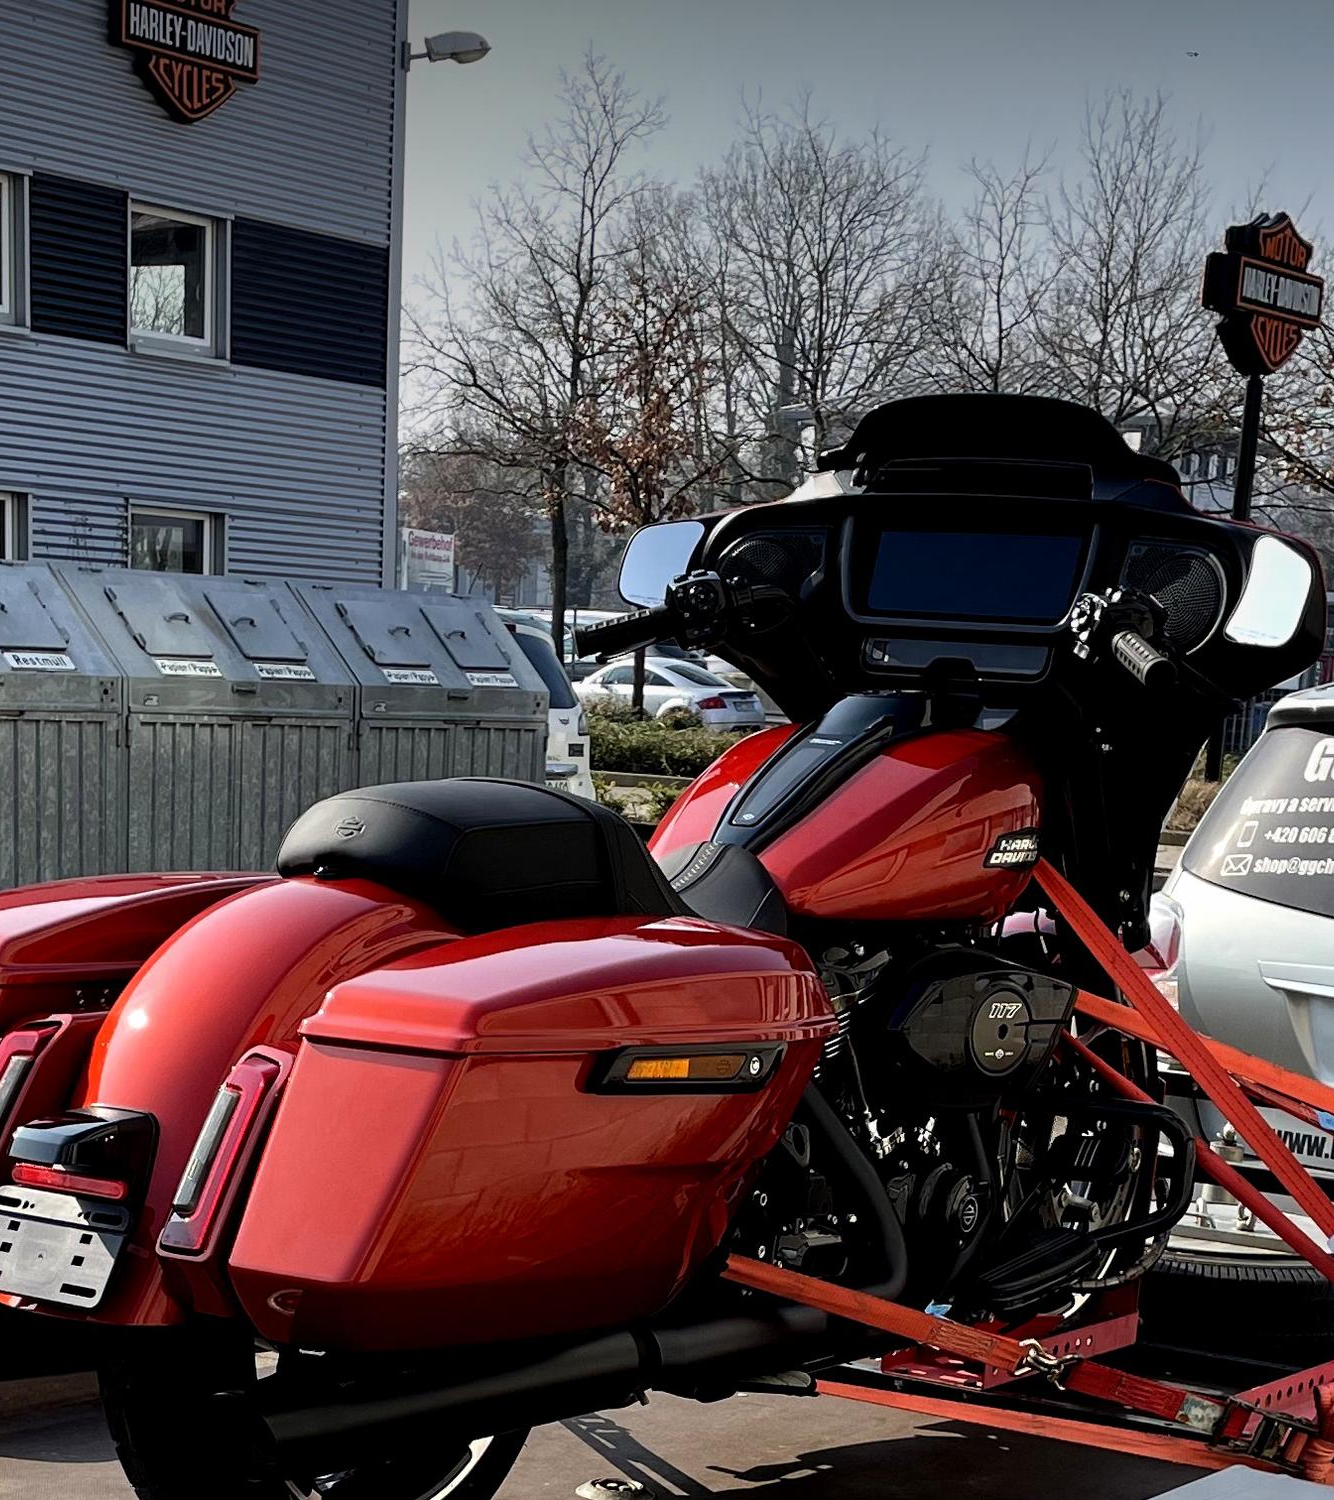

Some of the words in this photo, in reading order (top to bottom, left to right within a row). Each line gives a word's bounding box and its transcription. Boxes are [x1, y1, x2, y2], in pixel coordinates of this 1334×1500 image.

[130, 2, 254, 68] HARLEY-DAVIDSON
[159, 58, 225, 109] CYCLES
[1266, 227, 1307, 268] MOTOR
[1258, 316, 1298, 363] CYCLES
[14, 653, 67, 666] Restmüll
[1287, 798, 1299, 812] a
[1264, 827, 1299, 845] +420
[1300, 827, 1327, 844] 606
[989, 1003, 1022, 1019] 117
